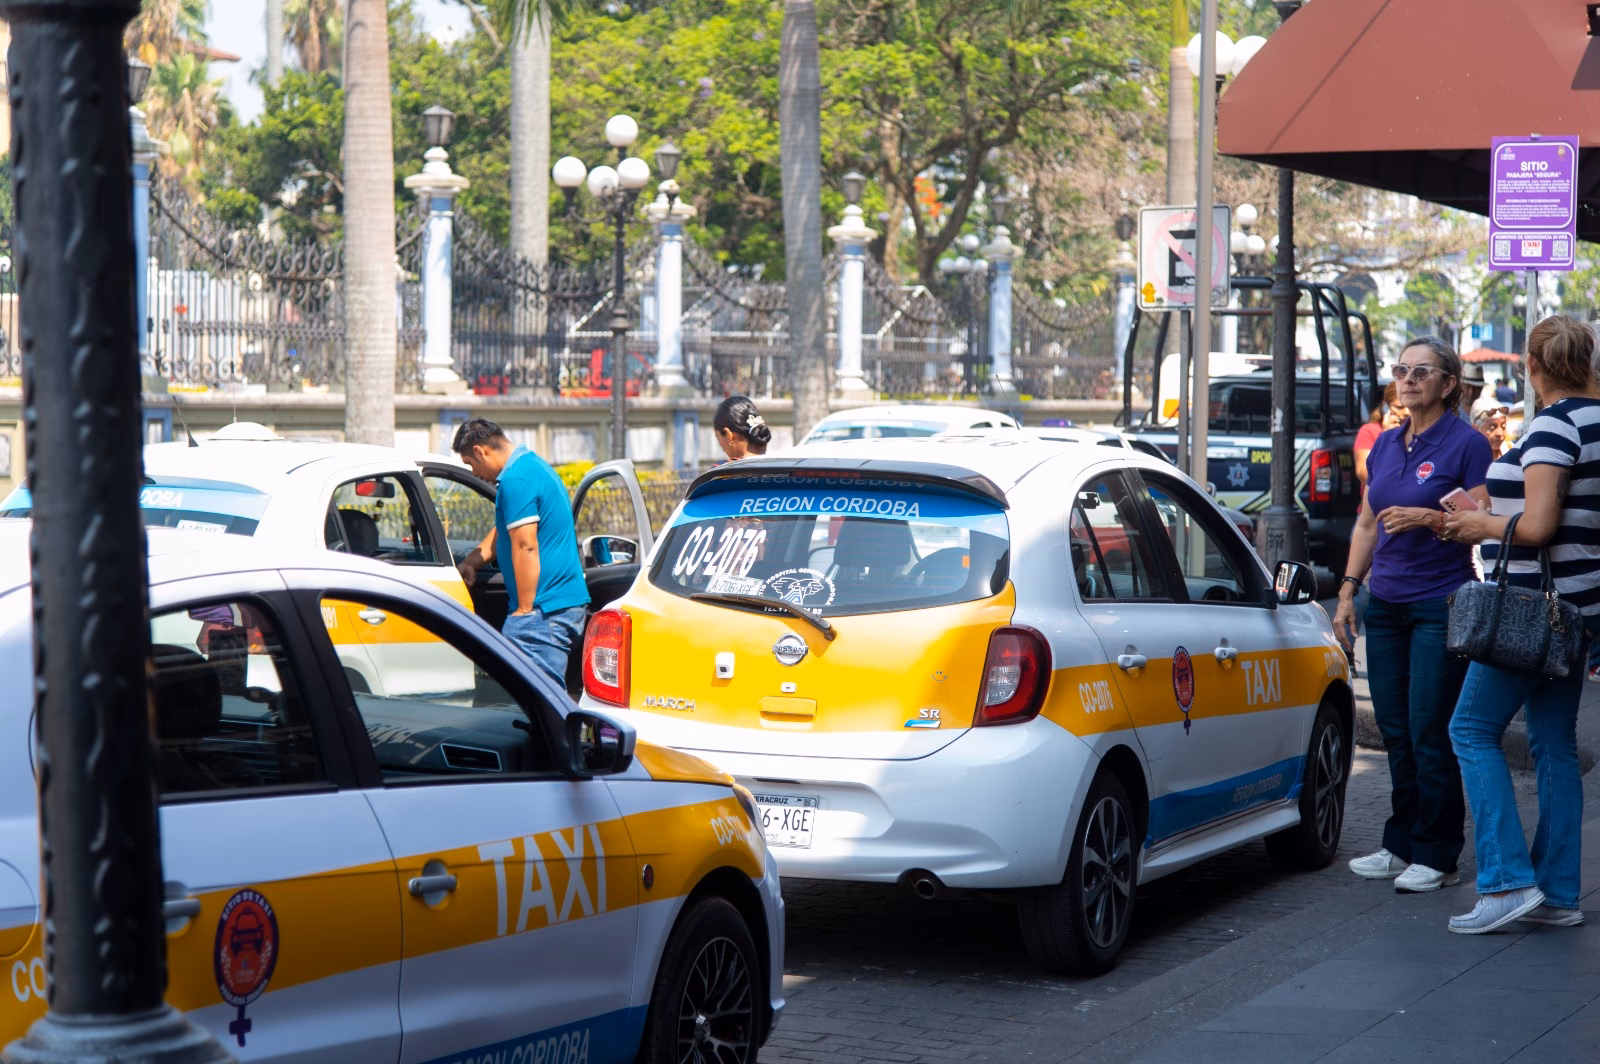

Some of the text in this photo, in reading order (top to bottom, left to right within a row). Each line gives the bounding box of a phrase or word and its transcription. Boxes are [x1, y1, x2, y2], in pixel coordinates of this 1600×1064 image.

[1520, 161, 1548, 171] SITIO
[739, 496, 920, 518] REGION CORDOBA
[675, 525, 768, 578] CO-2076
[765, 568, 798, 585] HOSPITAL
[774, 645, 806, 653] NISSAN
[1240, 658, 1281, 706] TAXI
[643, 695, 696, 711] MARCH
[918, 707, 941, 719] SR
[477, 823, 608, 937] TAXI
[221, 891, 273, 921] SITIO DE TAXI
